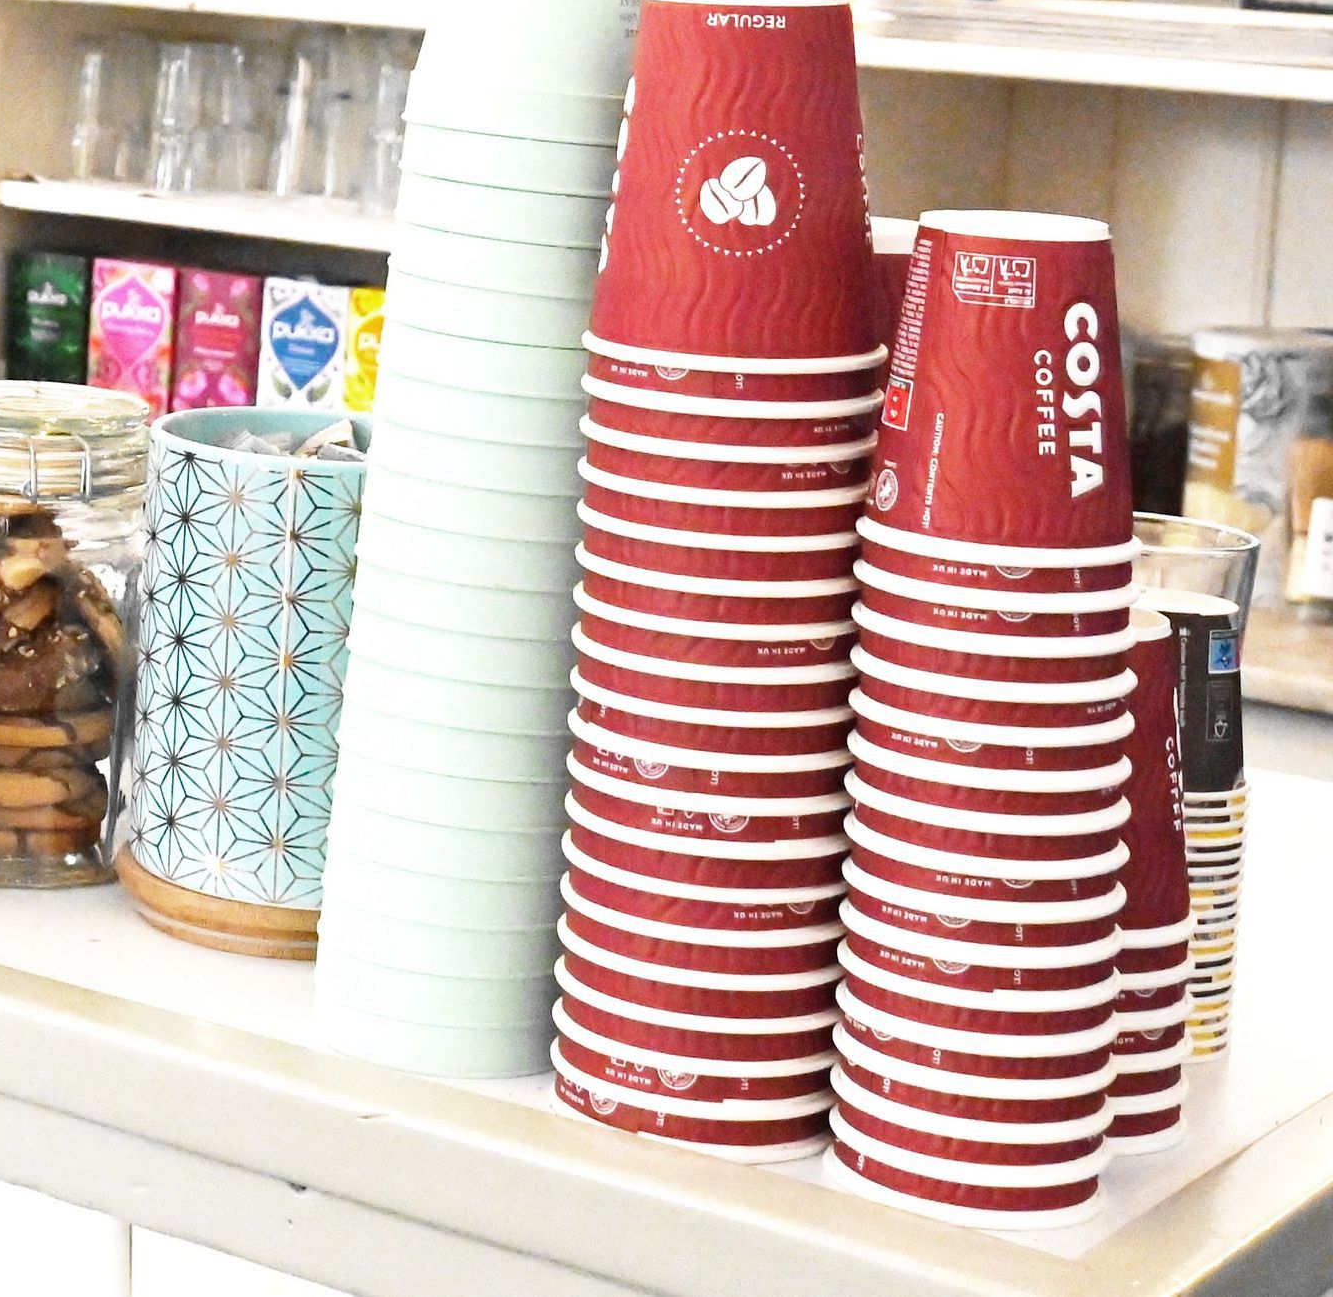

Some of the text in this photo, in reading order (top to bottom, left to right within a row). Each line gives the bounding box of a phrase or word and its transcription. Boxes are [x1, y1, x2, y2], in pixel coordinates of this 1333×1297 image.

[705, 12, 786, 29] REGULAR
[1033, 349, 1056, 456] COFFEE
[1062, 302, 1104, 498] COSTA
